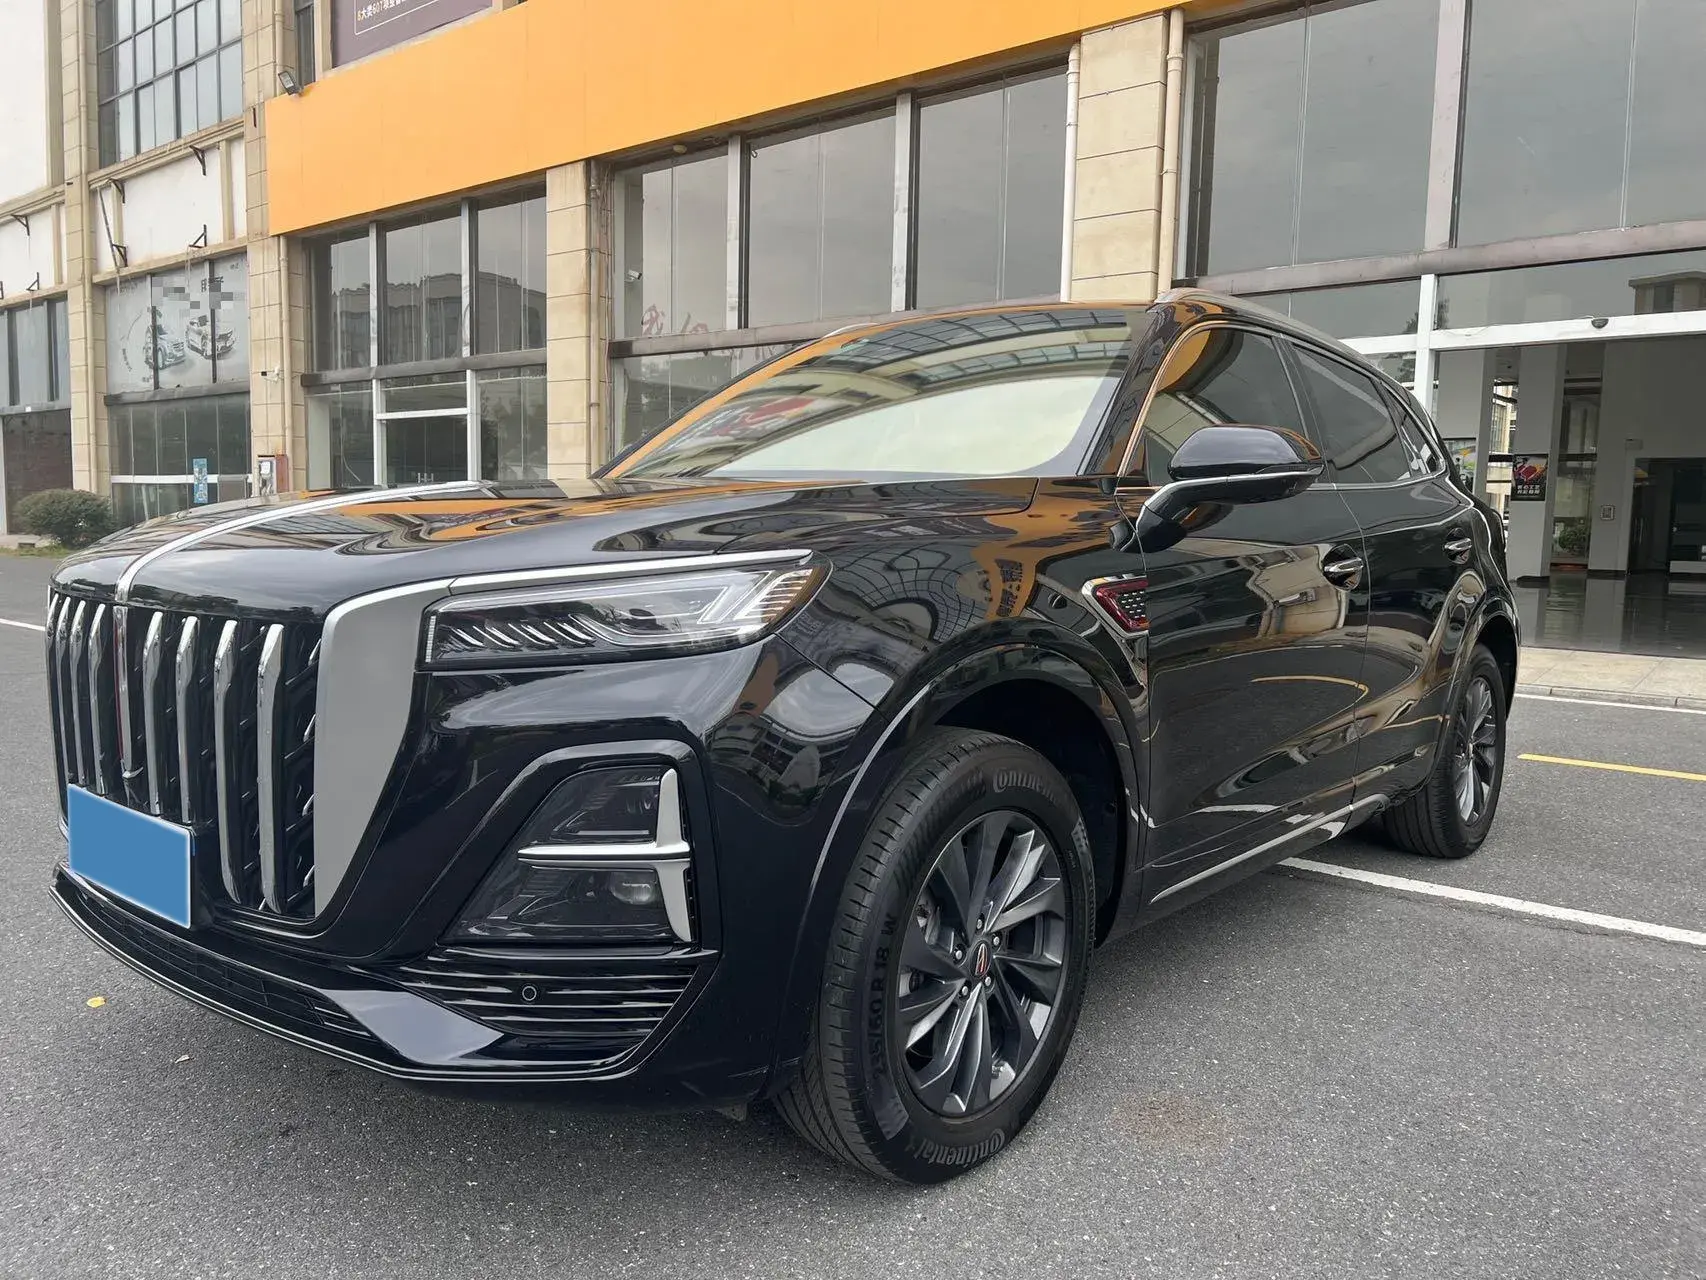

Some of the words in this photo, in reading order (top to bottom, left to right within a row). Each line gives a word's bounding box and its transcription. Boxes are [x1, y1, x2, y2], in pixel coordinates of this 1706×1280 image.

[874, 946, 889, 971] 18
[870, 978, 884, 992] R
[913, 1128, 1005, 1168] Continental
